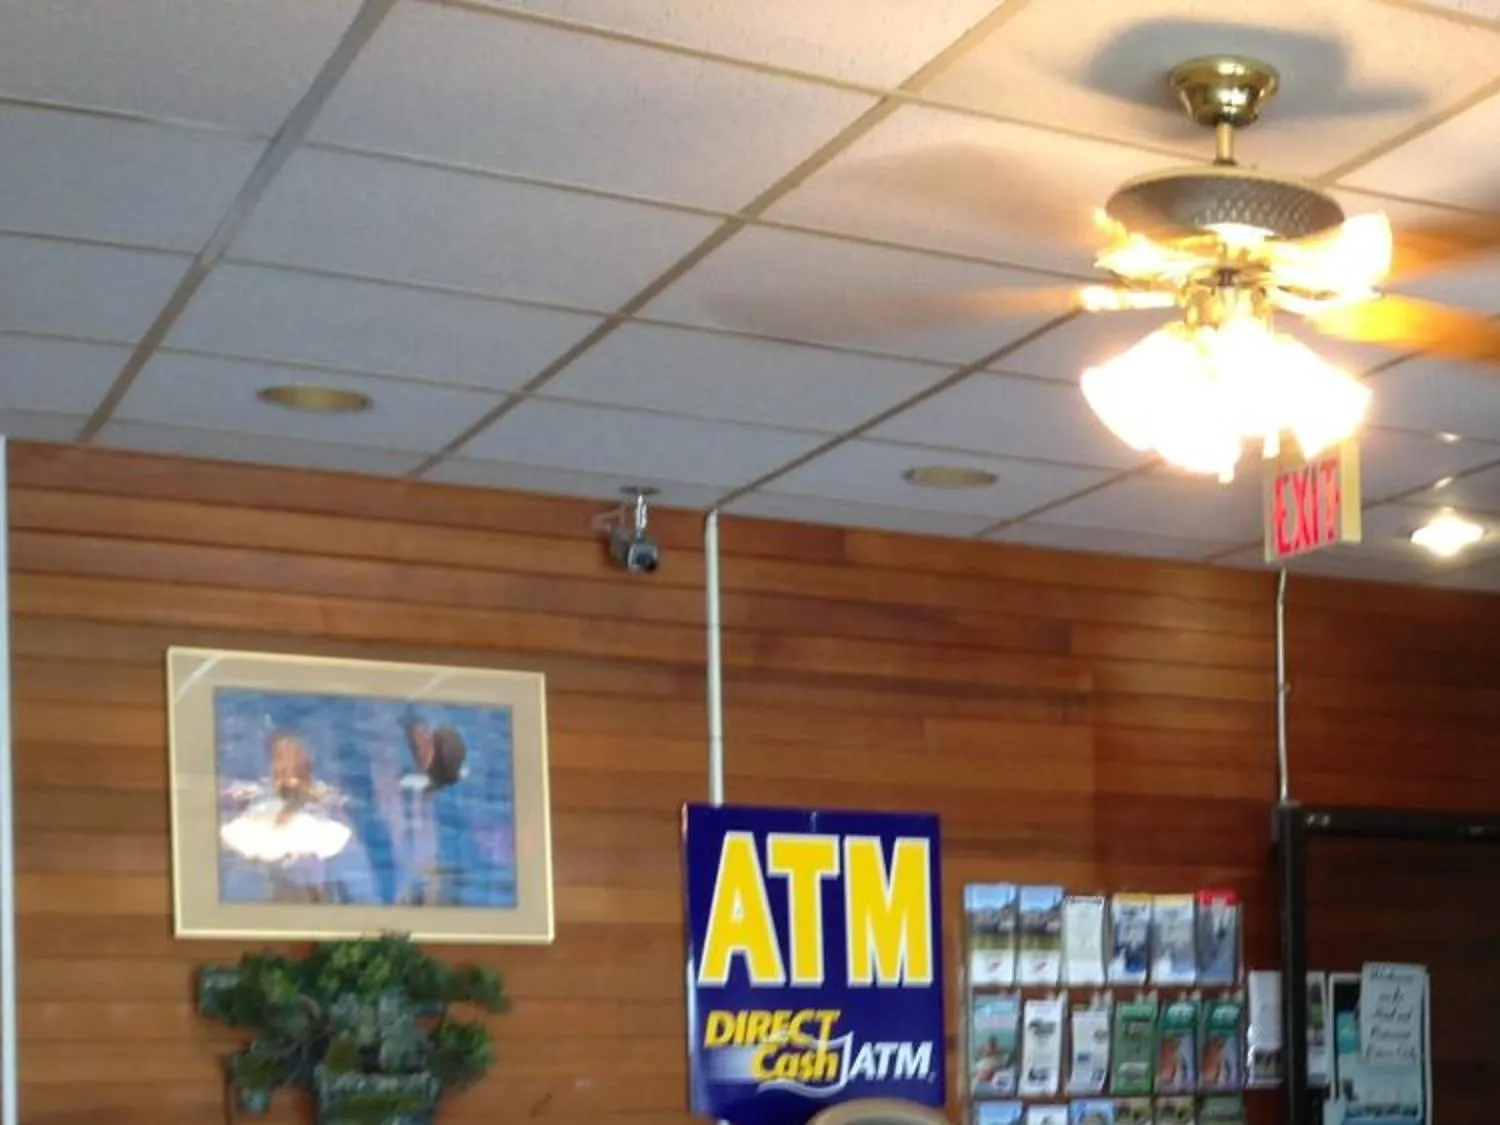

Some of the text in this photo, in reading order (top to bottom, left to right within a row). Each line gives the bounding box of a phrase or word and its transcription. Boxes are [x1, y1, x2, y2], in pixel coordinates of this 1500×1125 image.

[1274, 460, 1339, 556] EXIT
[697, 831, 933, 988] ATM
[704, 1009, 840, 1049] DIRECT
[752, 1041, 933, 1082] Cash ATM
